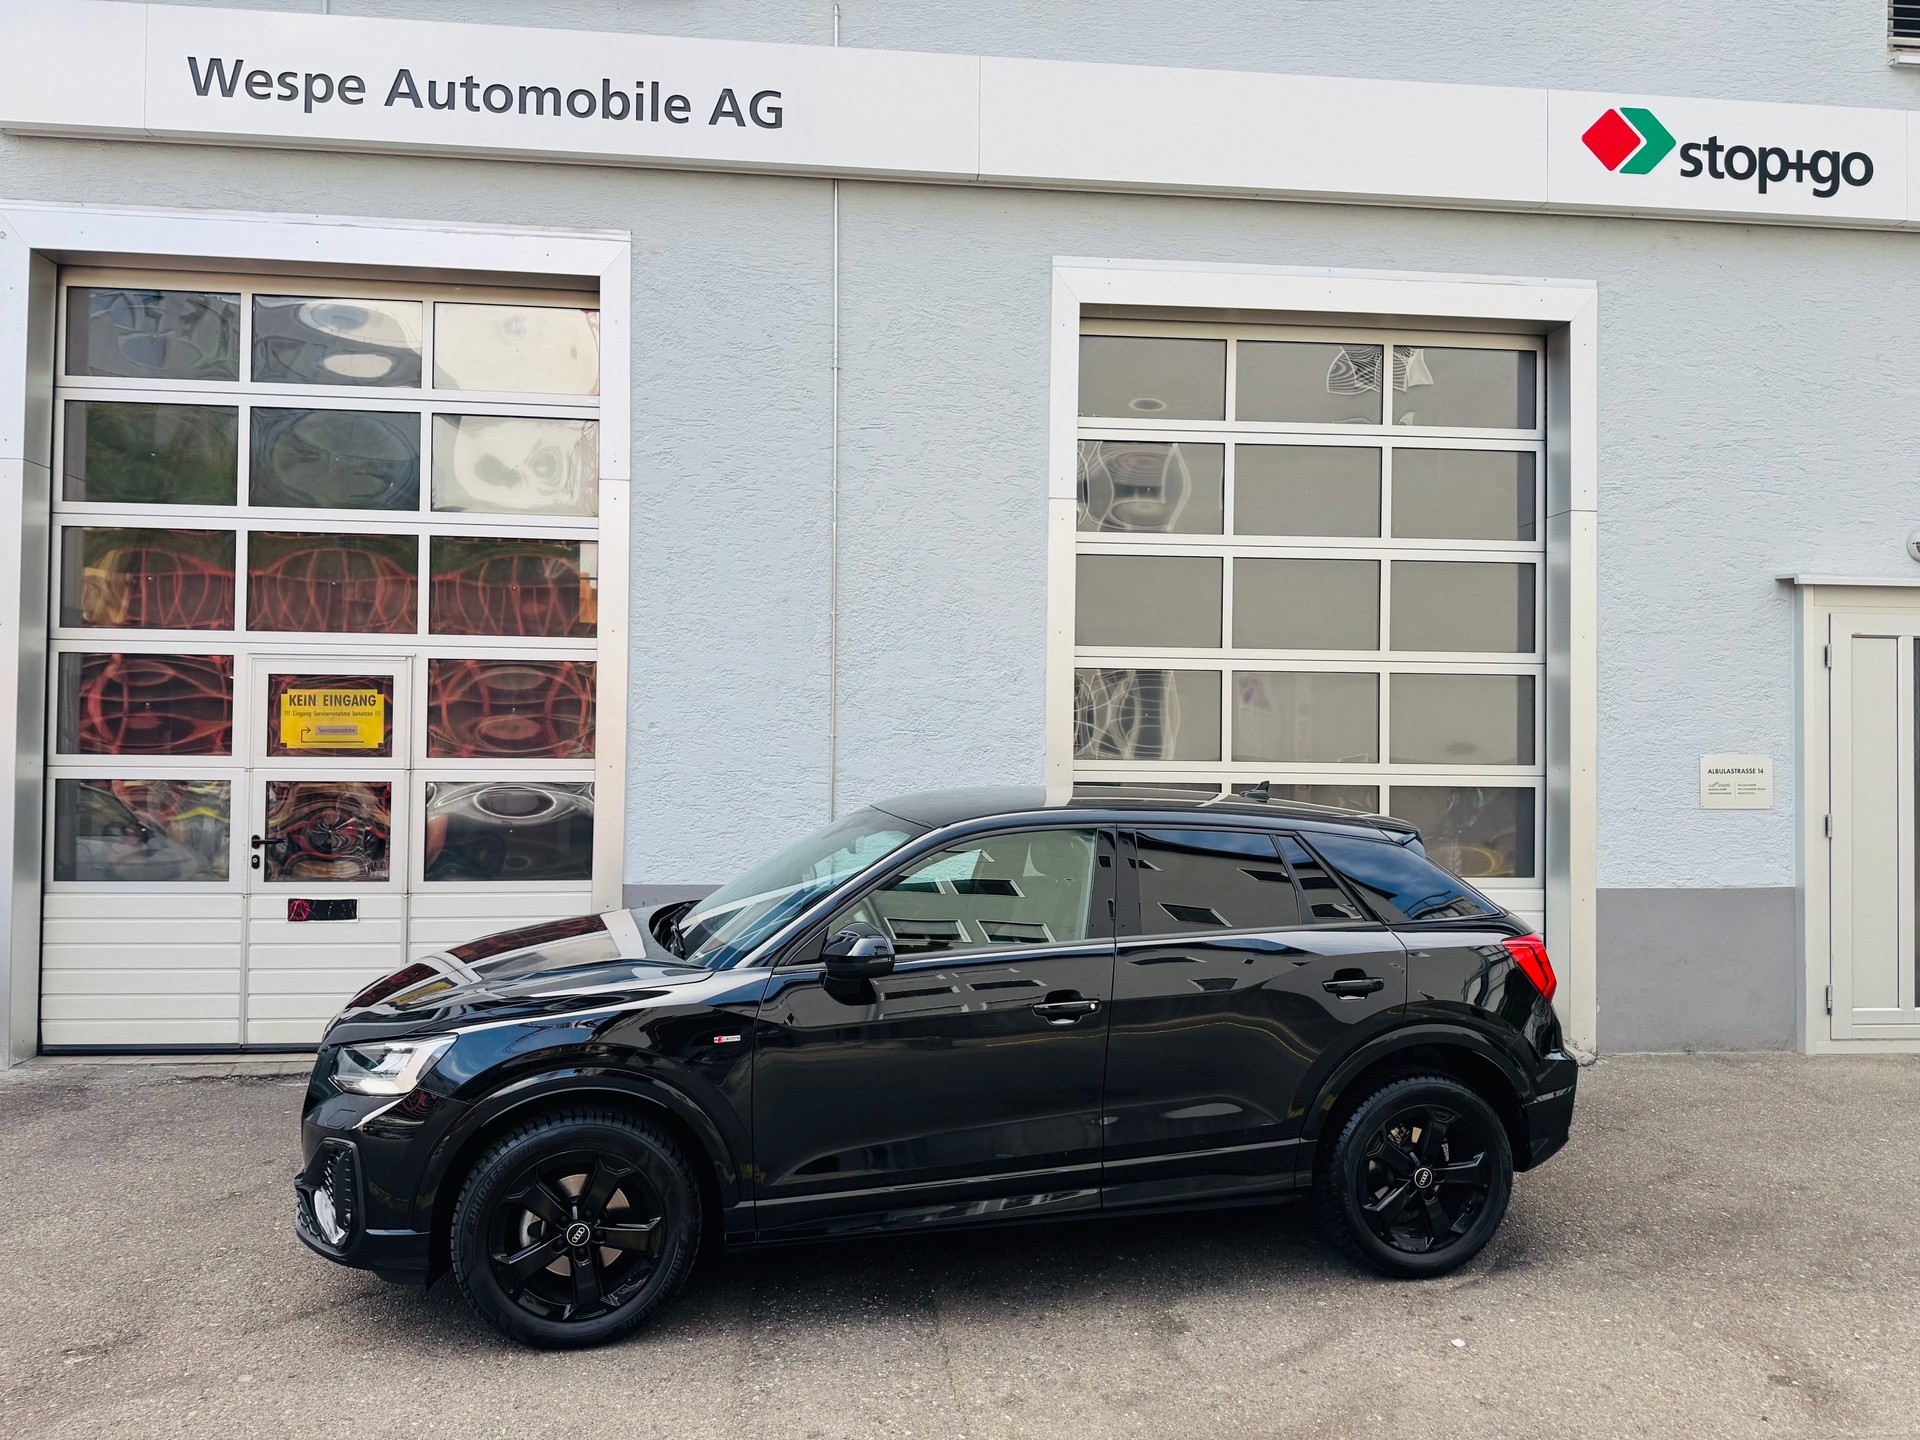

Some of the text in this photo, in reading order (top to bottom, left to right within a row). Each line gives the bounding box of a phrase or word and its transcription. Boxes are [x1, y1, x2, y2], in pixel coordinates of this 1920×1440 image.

[187, 57, 783, 129] Wespe Automobile AG
[1679, 136, 1874, 198] stop+go
[289, 694, 376, 706] KEIN EINGANG
